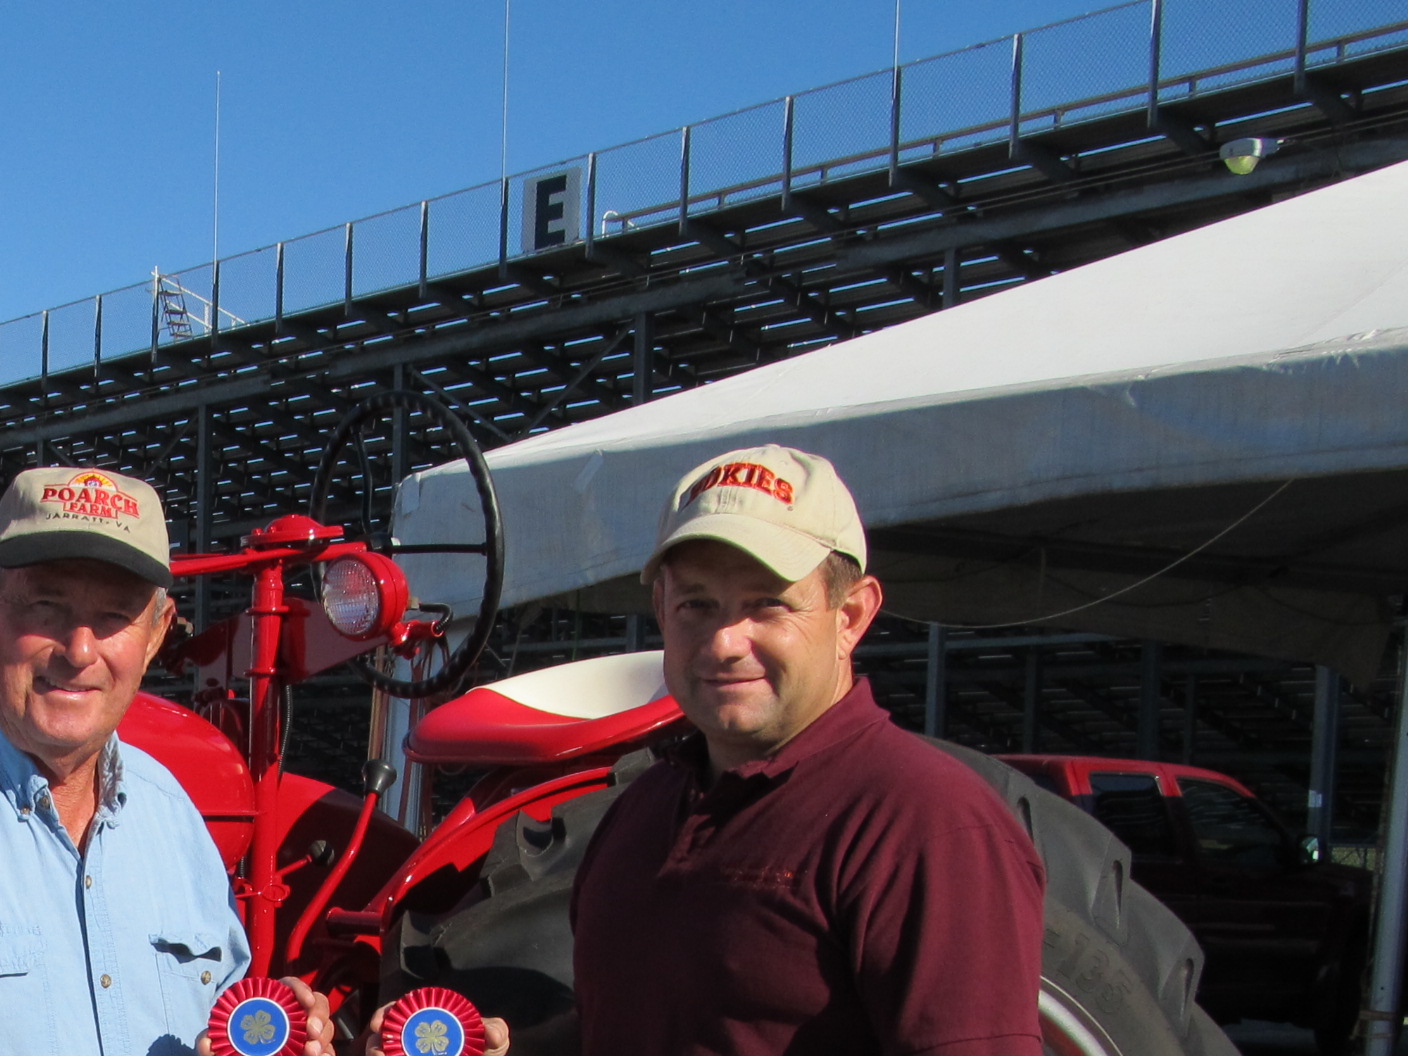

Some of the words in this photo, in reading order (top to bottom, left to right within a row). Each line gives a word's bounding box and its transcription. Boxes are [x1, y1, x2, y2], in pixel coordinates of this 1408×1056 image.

[535, 175, 567, 250] E
[42, 487, 140, 518] POARCH
[69, 502, 113, 518] FARM
[115, 521, 131, 533] VA
